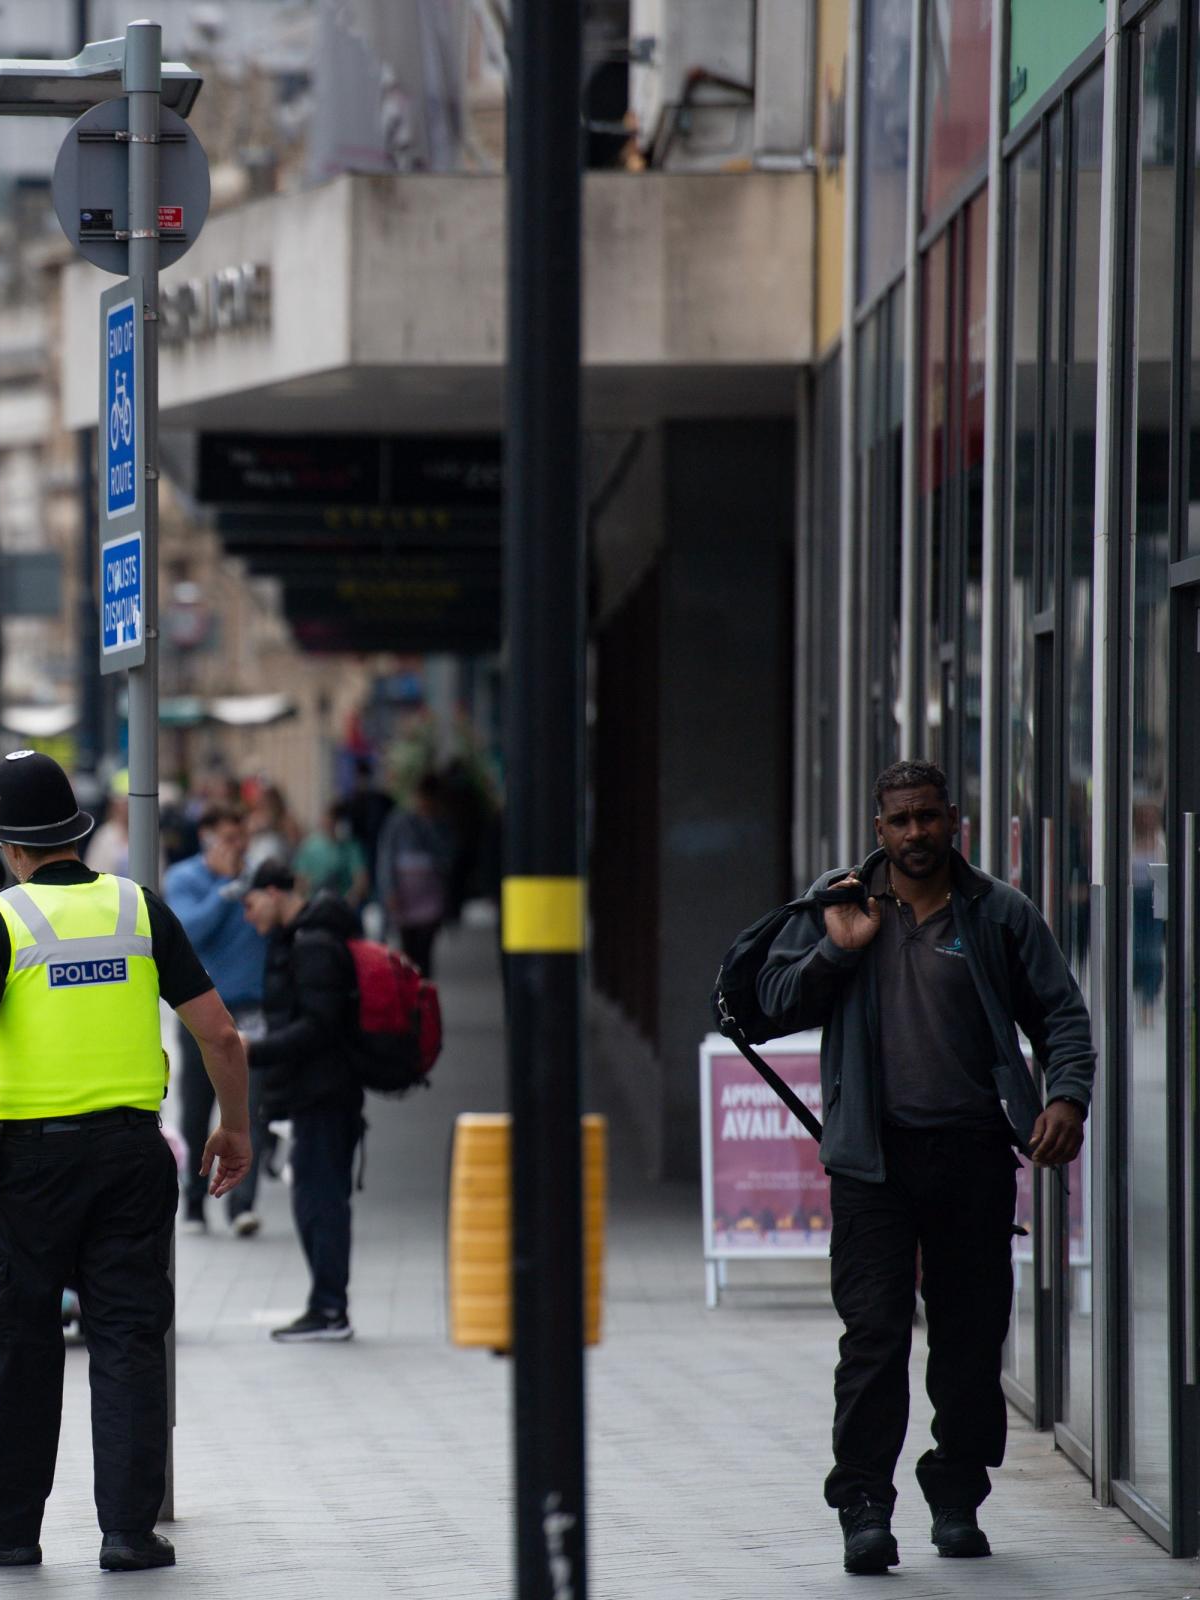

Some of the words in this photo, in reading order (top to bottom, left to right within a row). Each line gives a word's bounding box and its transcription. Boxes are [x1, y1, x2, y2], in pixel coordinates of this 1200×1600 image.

[109, 327, 123, 358] END
[123, 321, 133, 352] OF
[111, 462, 132, 497] ROUTE
[52, 962, 124, 983] POLICE
